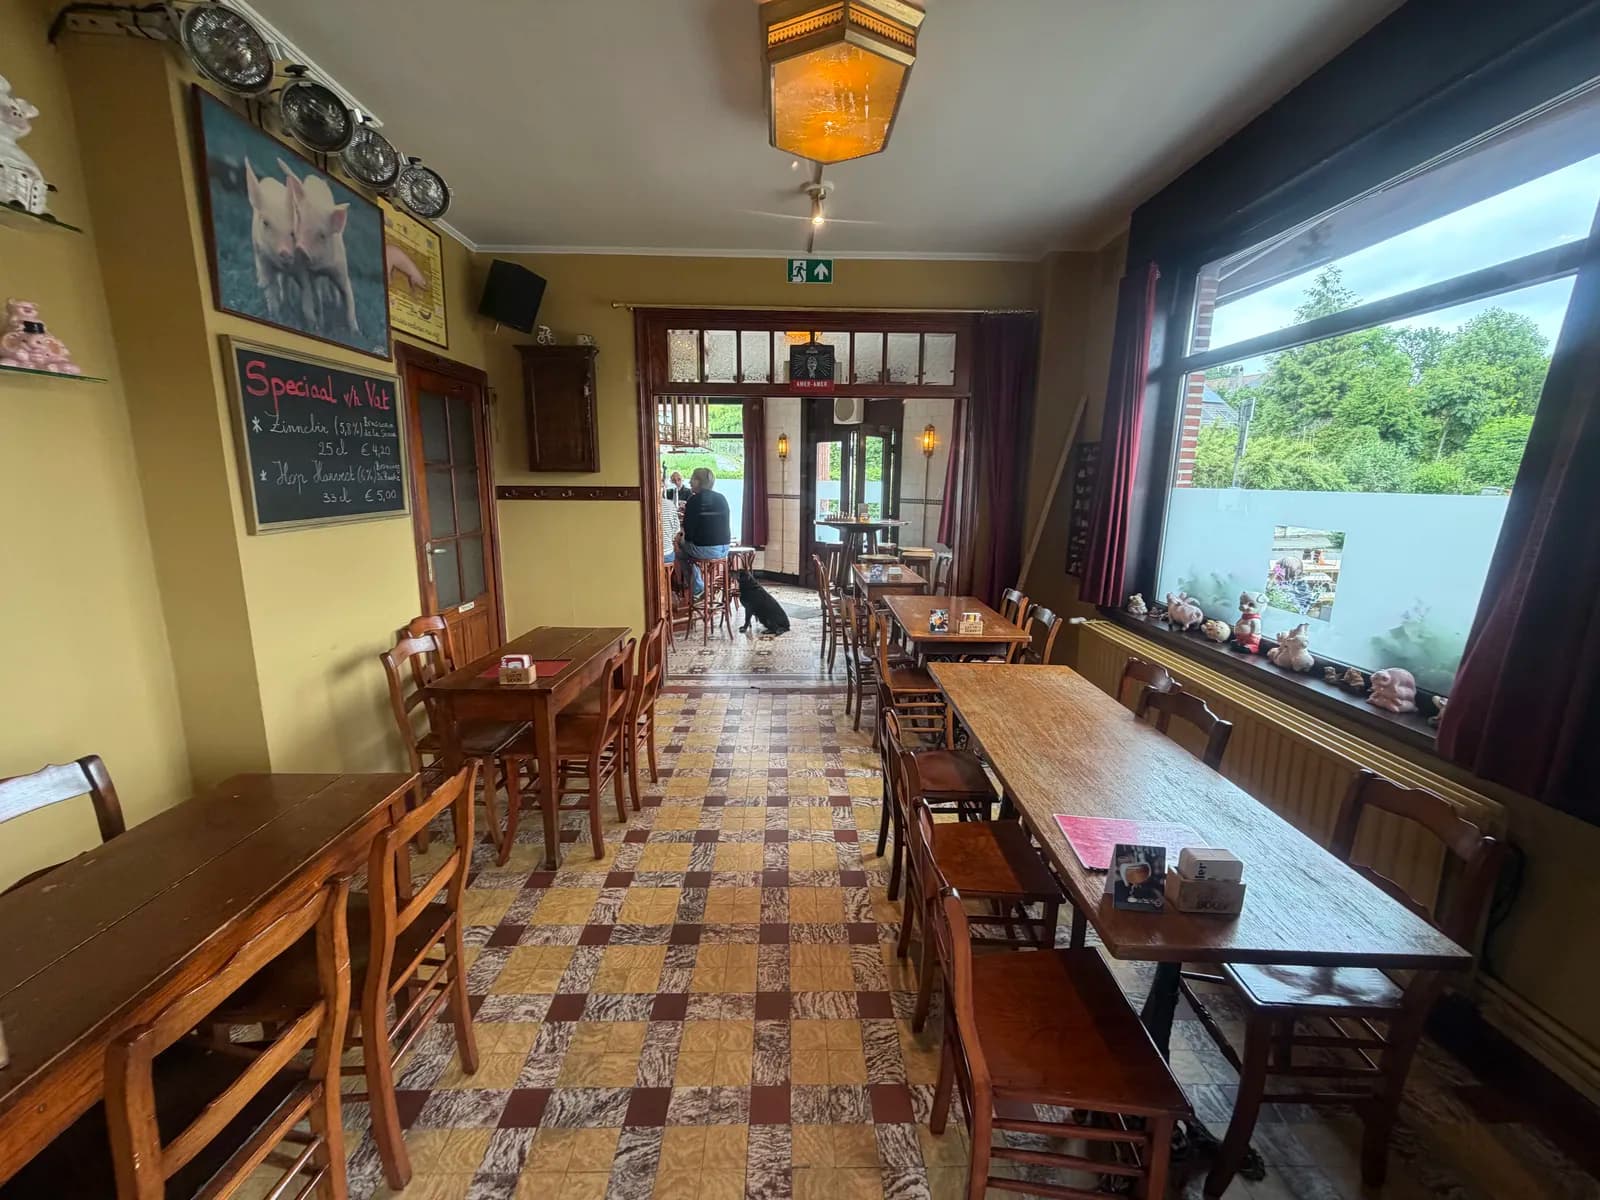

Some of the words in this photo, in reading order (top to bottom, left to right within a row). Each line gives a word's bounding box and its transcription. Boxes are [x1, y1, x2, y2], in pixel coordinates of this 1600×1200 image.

[365, 380, 391, 410] Vat
[318, 441, 334, 455] 25
[271, 460, 308, 495] Hop
[323, 492, 337, 503] 33
